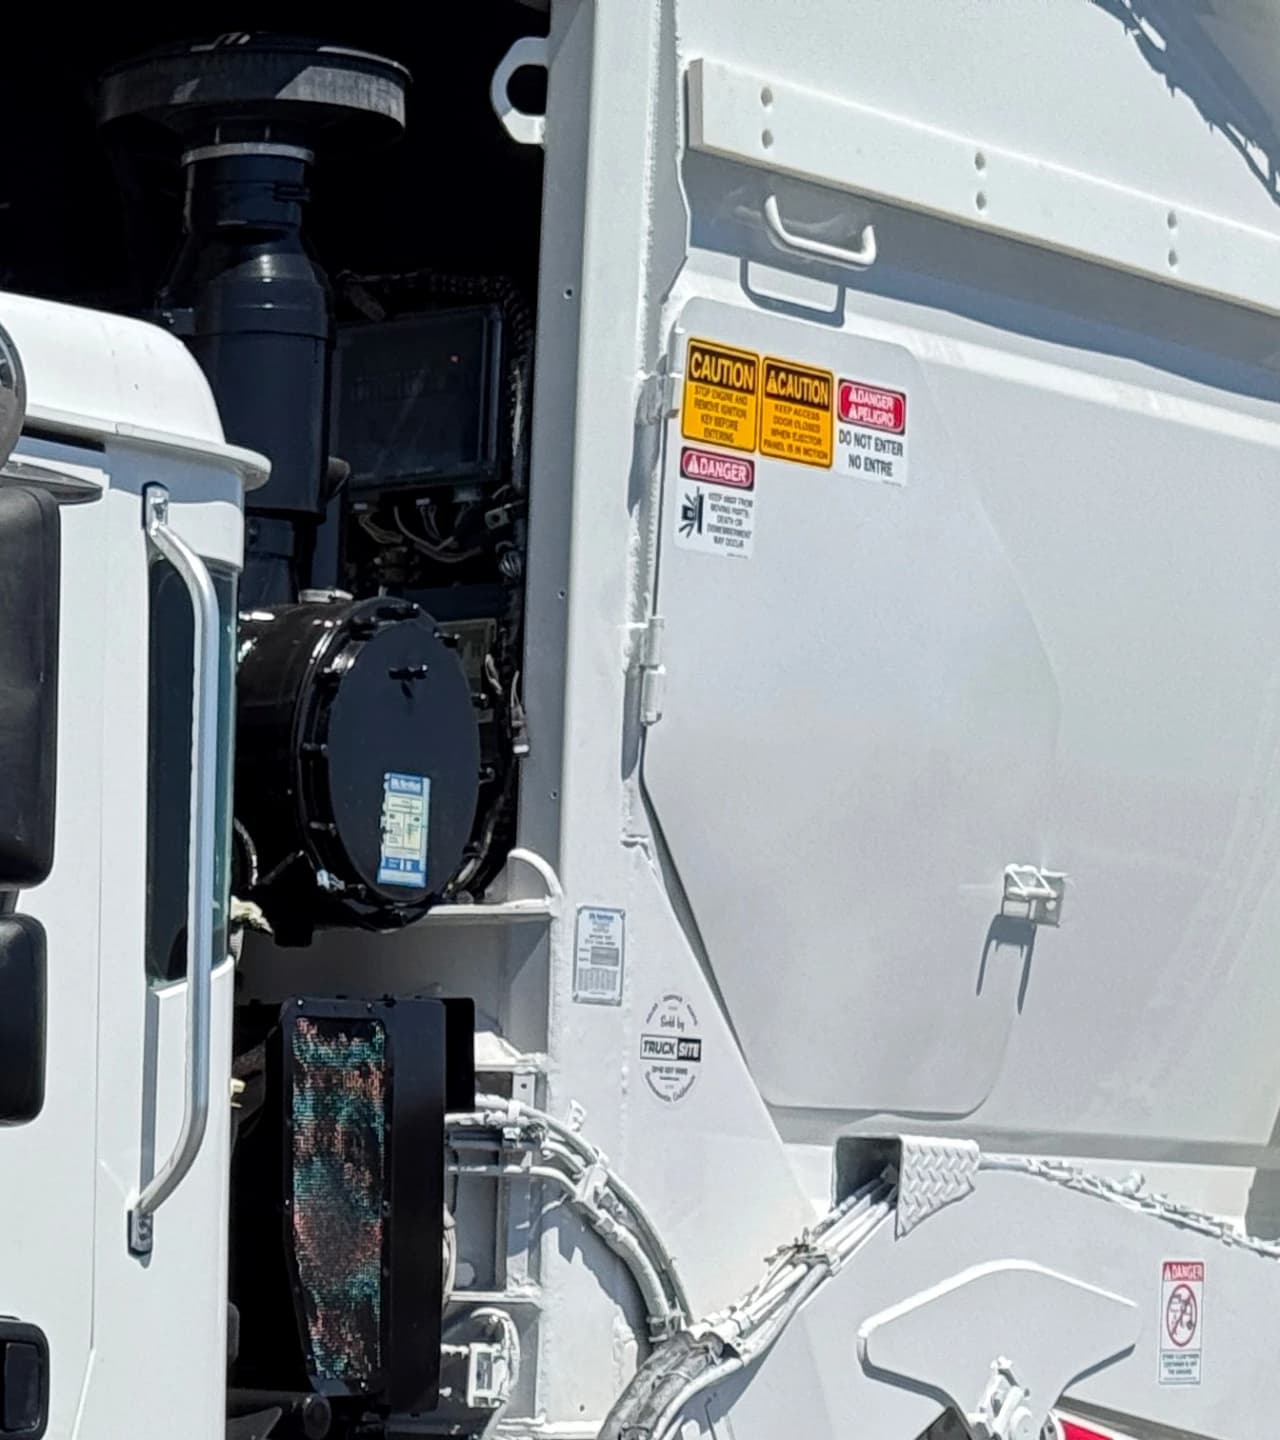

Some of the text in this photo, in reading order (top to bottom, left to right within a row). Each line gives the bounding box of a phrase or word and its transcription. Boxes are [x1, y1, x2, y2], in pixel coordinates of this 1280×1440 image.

[691, 351, 754, 390] CAUTION
[694, 385, 710, 397] STOP
[778, 372, 829, 406] CAUTION
[858, 388, 894, 411] DANGER
[858, 406, 894, 427] PELIGRO
[839, 429, 903, 457] DO NOT ENTER
[700, 457, 747, 483] DANGER
[848, 454, 893, 477] NO ENTRE
[643, 1040, 676, 1055] TRUCK
[1171, 1263, 1201, 1280] DANGER
